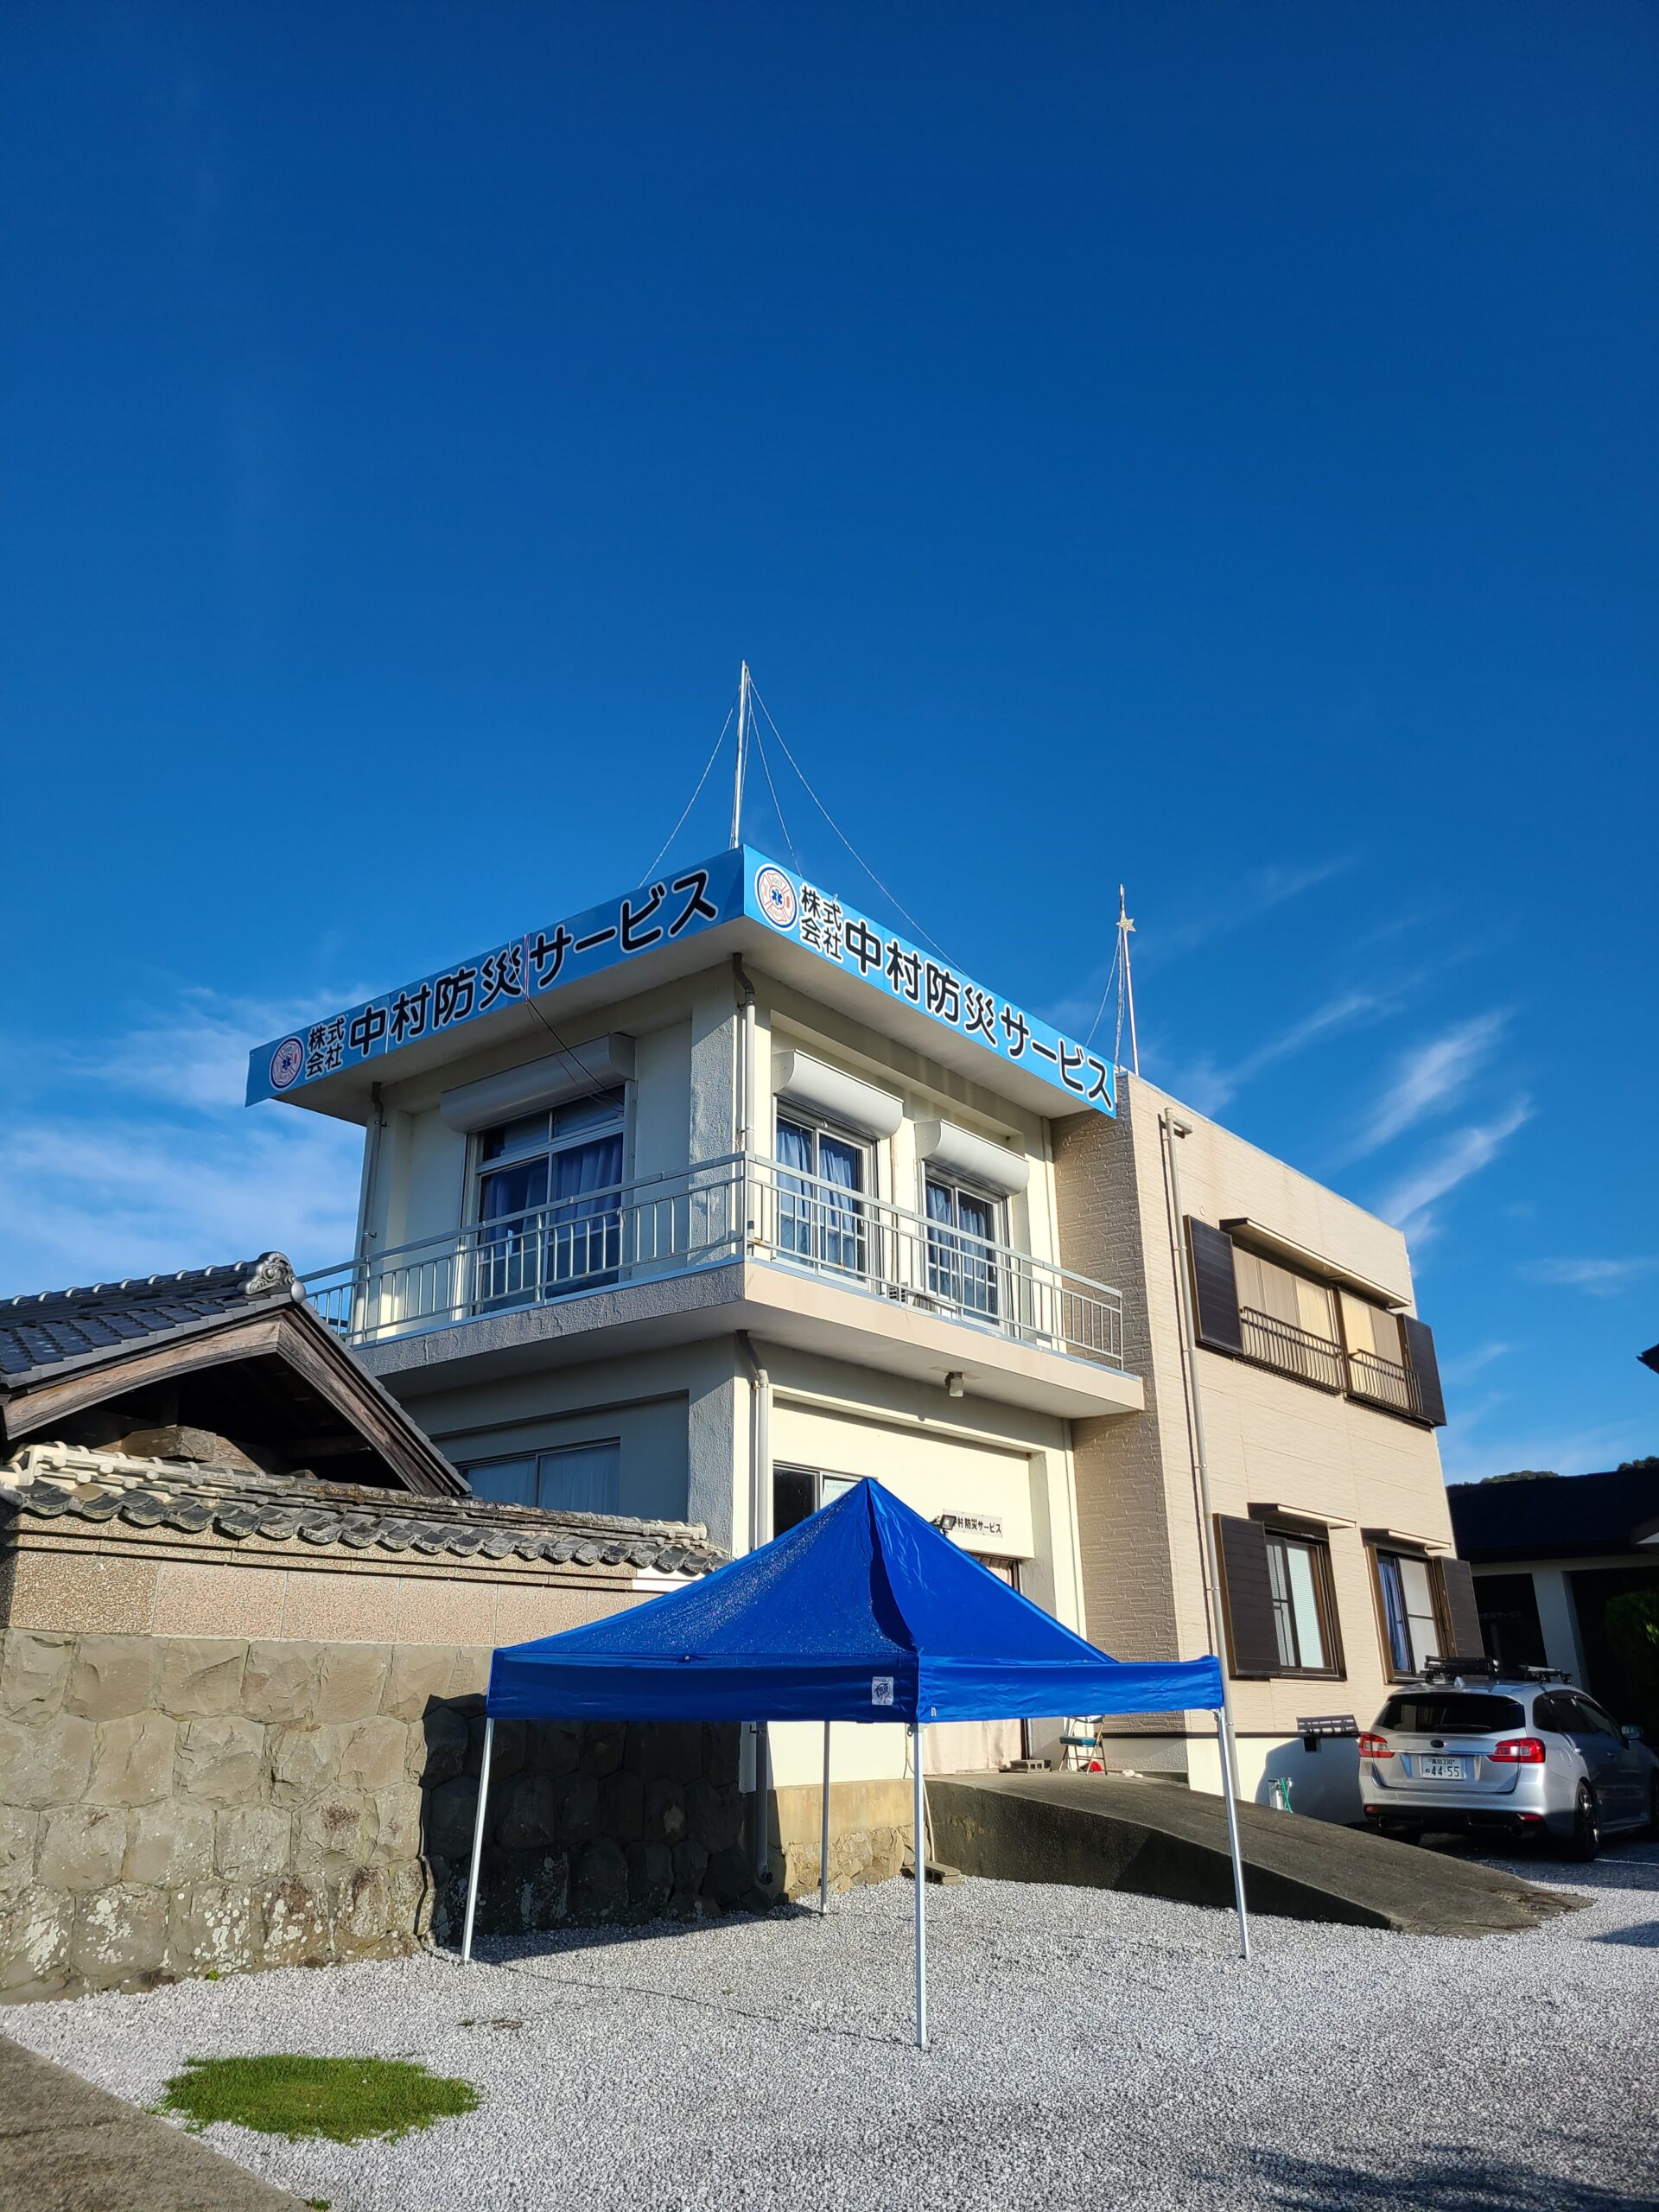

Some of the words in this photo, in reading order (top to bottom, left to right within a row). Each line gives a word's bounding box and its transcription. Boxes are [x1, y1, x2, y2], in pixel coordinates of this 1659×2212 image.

[801, 886, 842, 931] 株式
[801, 918, 842, 960] 会社
[348, 869, 717, 1056] 中村防災サービス
[308, 1017, 345, 1052] 株式
[844, 920, 1113, 1109] 中村防災サービス
[306, 1044, 343, 1077] 会社
[1431, 1765, 1459, 1777] 44-55
